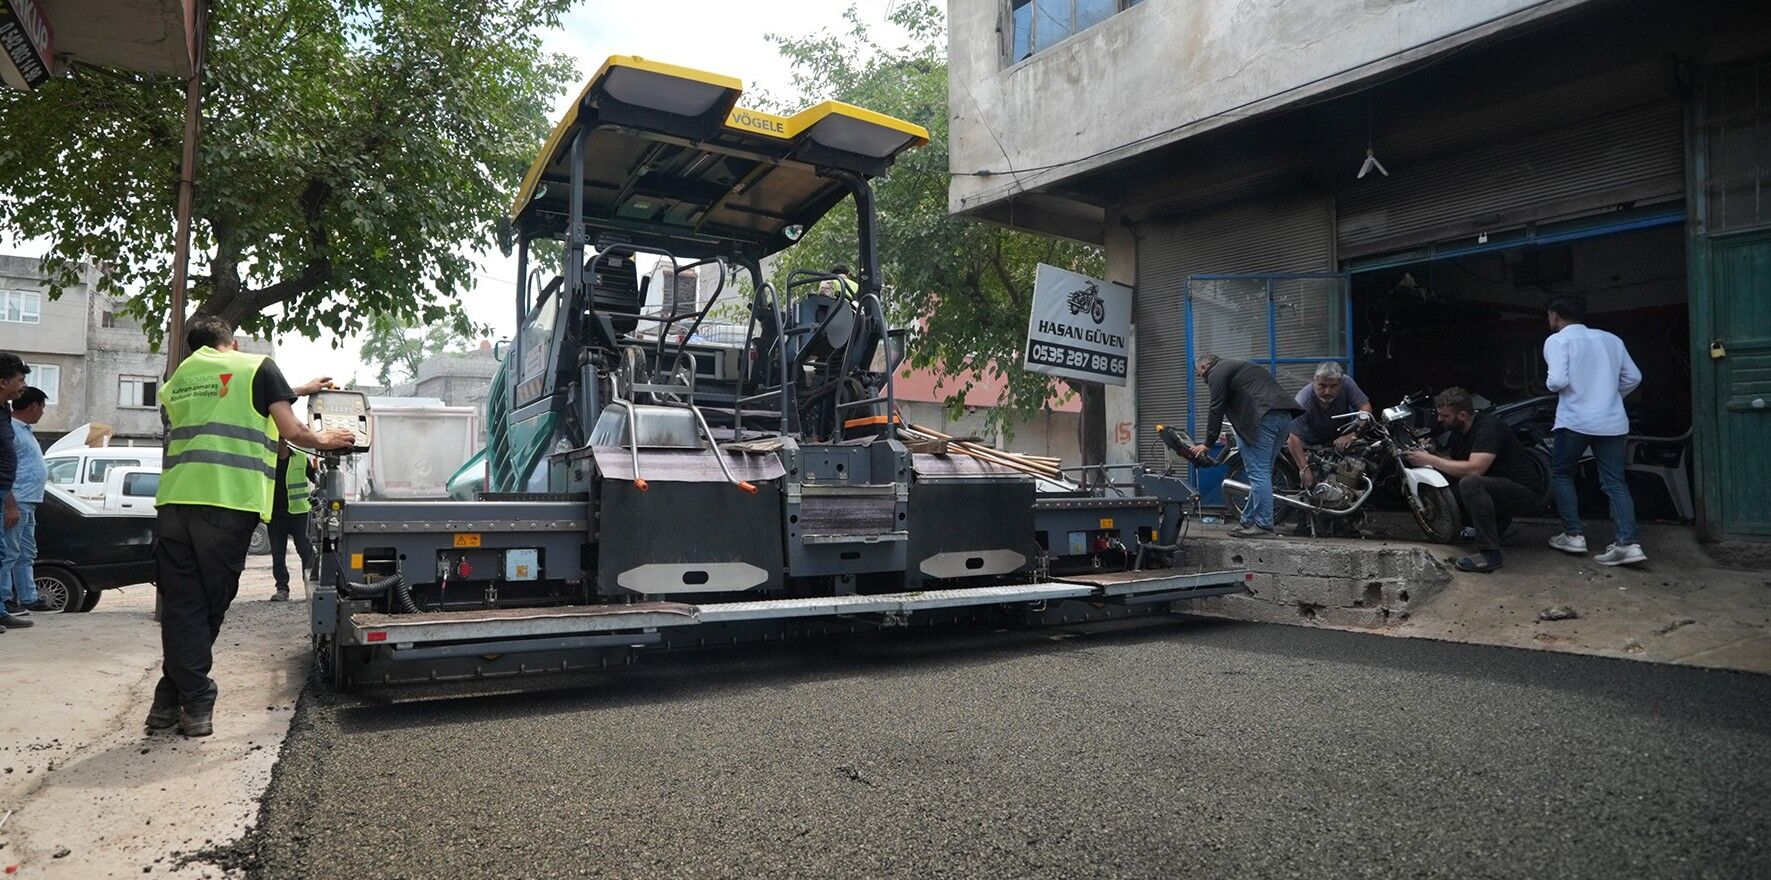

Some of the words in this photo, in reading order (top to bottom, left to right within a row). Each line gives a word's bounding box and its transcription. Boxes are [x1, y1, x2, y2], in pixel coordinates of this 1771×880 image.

[732, 112, 784, 134] VÖGELE
[1039, 320, 1083, 340] HASAN
[1085, 328, 1125, 348] GÜVEN
[1032, 344, 1064, 363] 0535
[1066, 349, 1090, 367] 287
[1091, 354, 1108, 371] 88
[1110, 358, 1125, 374] 66
